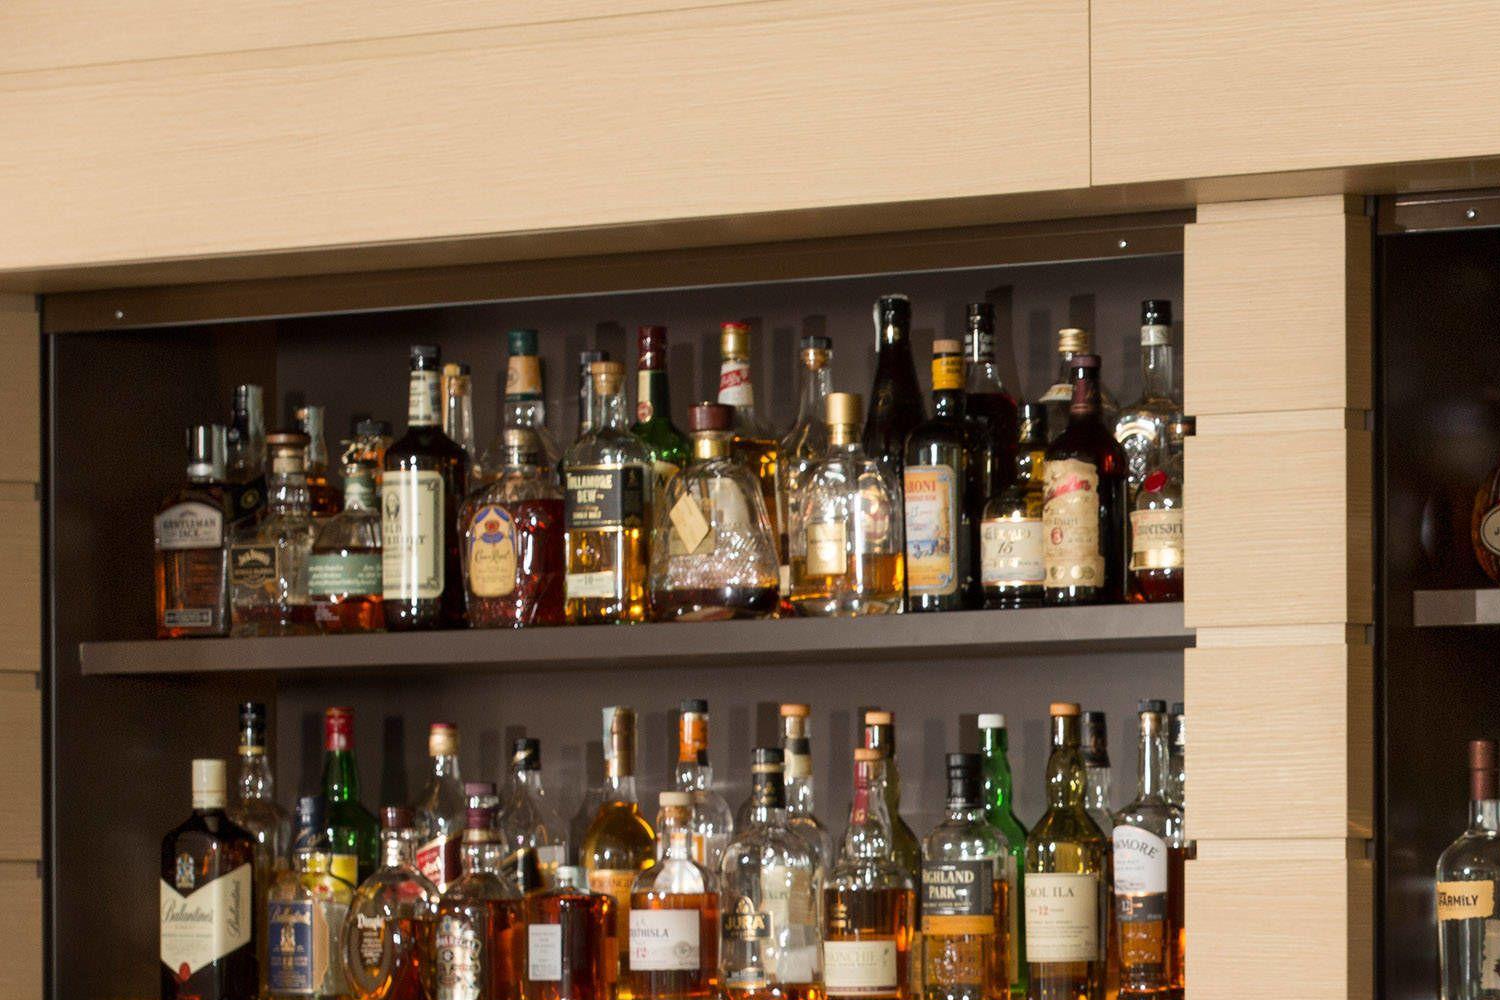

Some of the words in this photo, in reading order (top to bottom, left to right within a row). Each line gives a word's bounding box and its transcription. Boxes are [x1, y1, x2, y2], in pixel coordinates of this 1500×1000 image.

[928, 885, 956, 900] PARK
[1052, 886, 1075, 898] ILA
[724, 912, 767, 930] JURA
